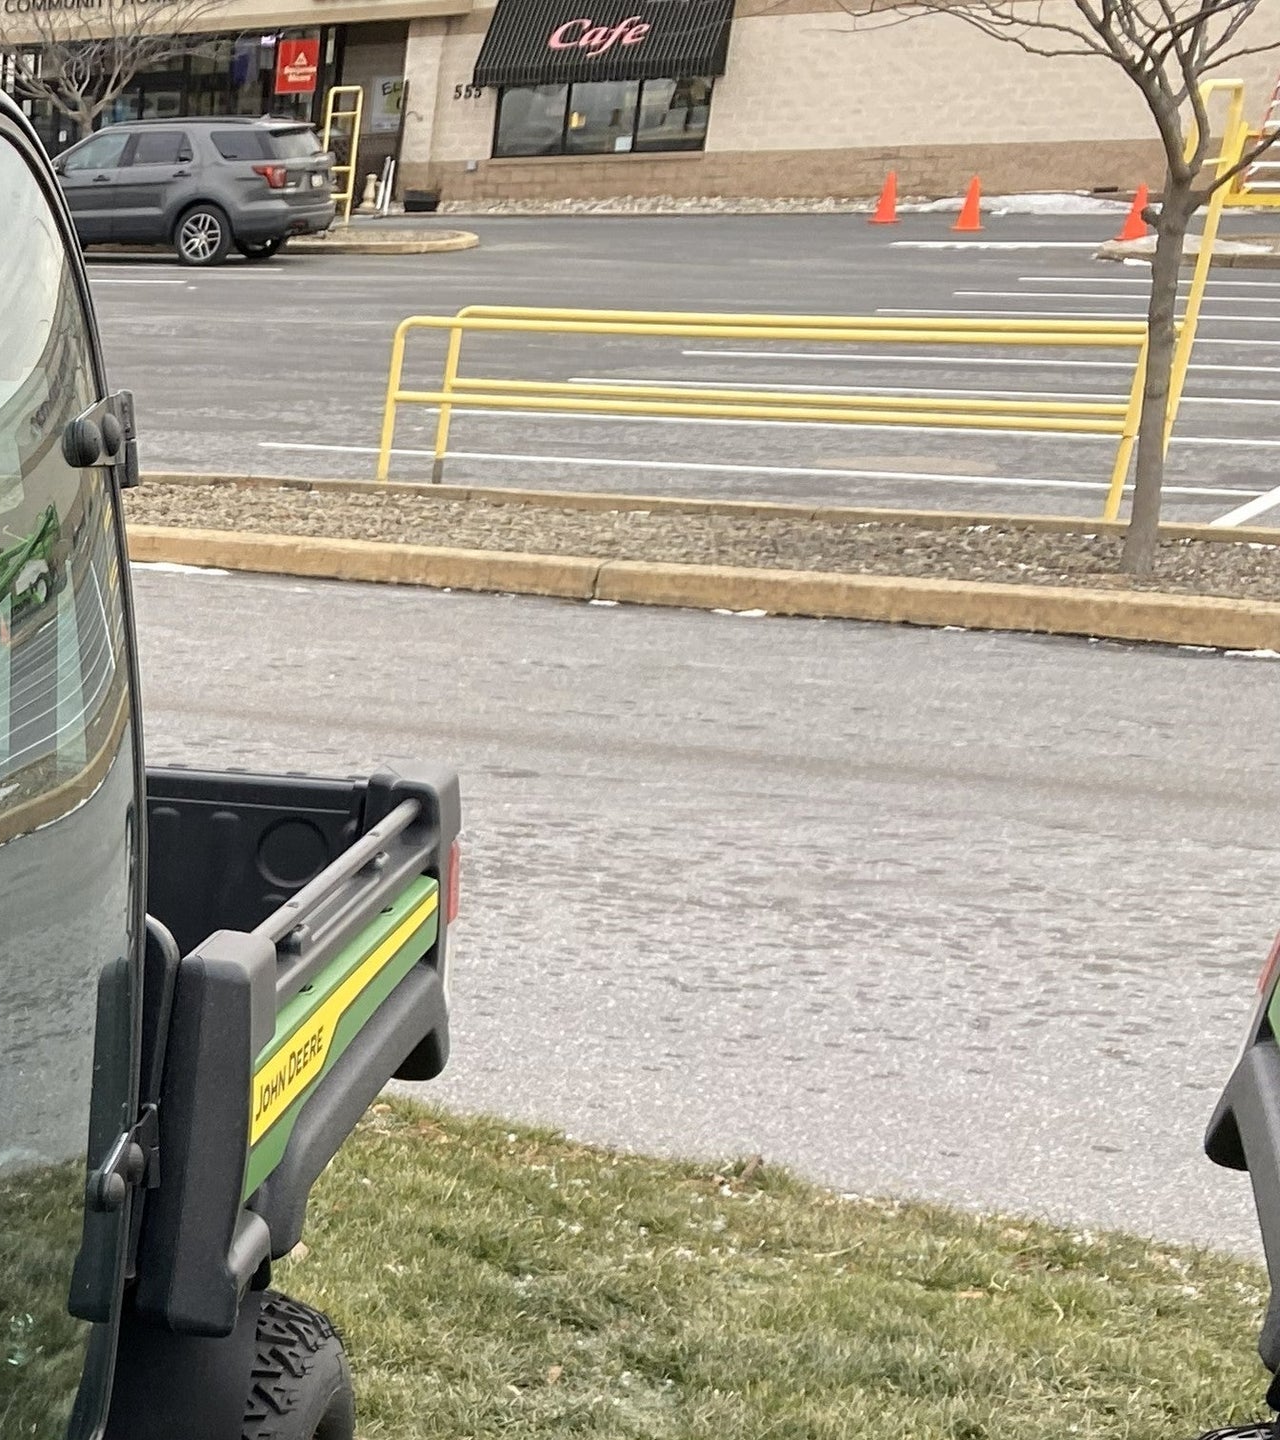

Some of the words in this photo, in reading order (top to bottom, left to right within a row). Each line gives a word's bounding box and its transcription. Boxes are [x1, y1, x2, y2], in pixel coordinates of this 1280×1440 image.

[547, 15, 650, 57] Cafe
[454, 83, 482, 99] 555
[255, 1064, 287, 1122] JOHN
[287, 1024, 325, 1086] DEERE
